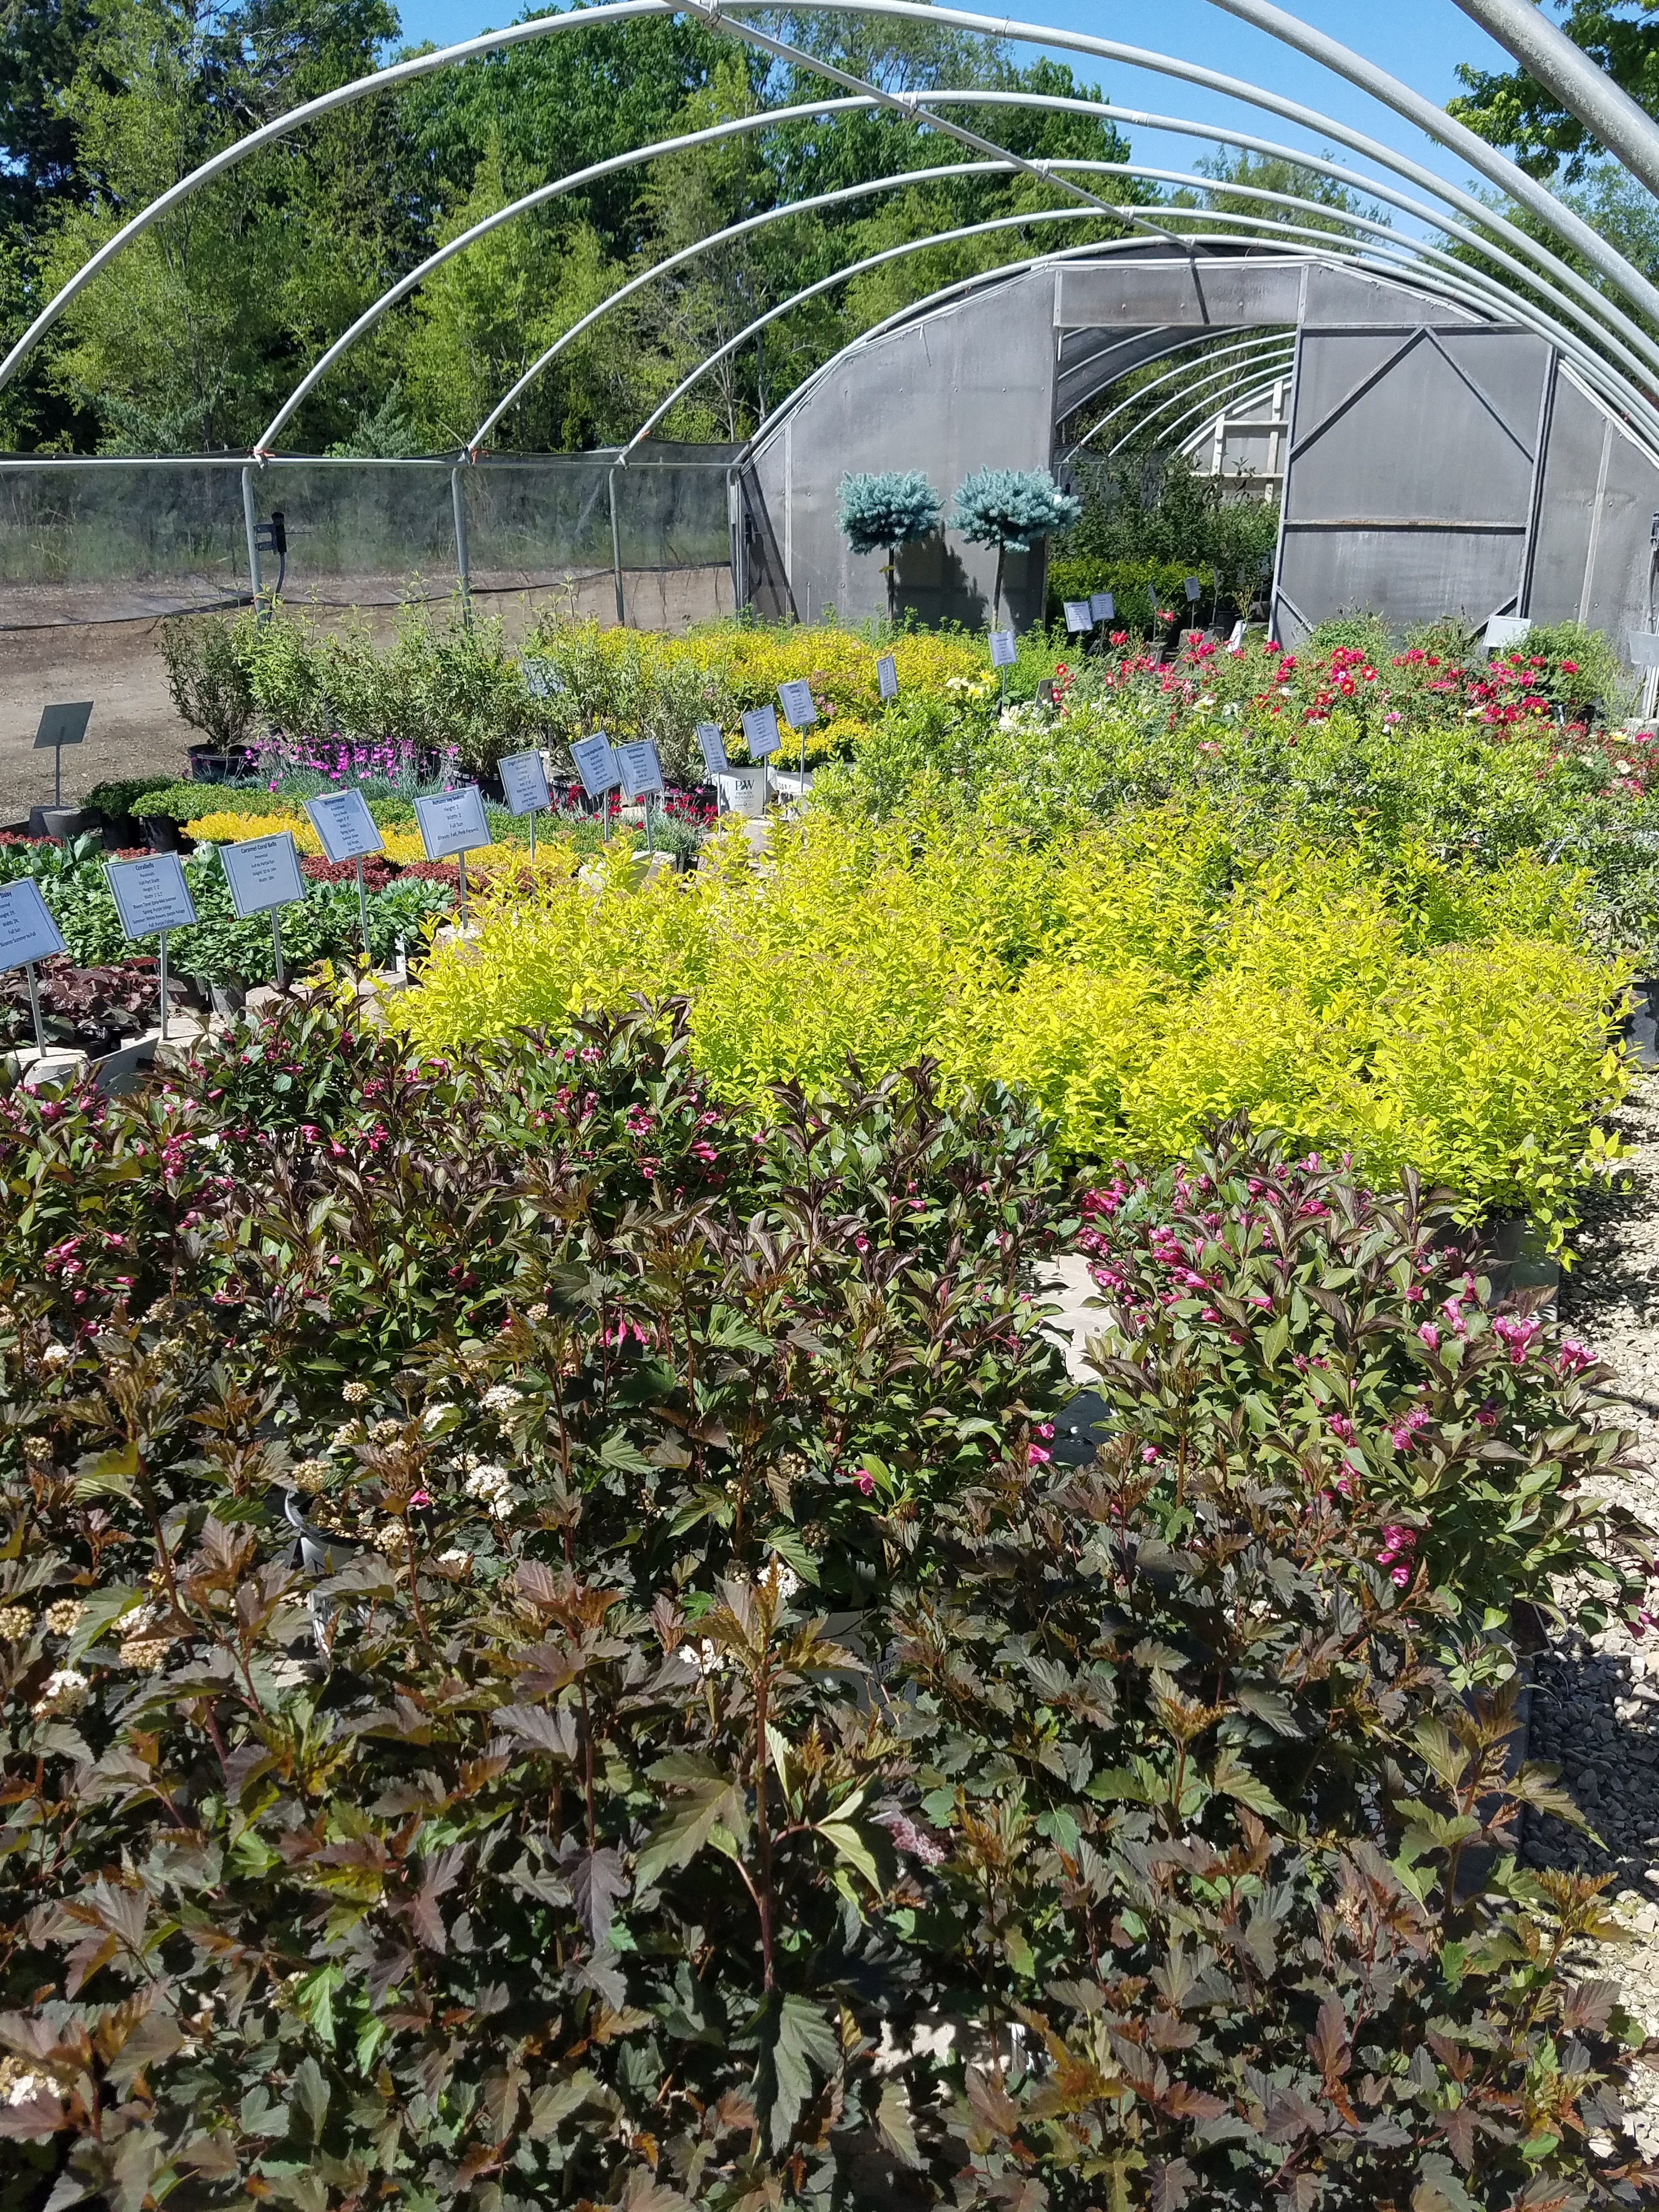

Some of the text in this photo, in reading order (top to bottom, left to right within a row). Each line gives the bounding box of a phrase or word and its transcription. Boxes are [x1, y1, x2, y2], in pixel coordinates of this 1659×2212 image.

[735, 779, 755, 791] PW
[135, 862, 154, 871] Coralbells
[0, 891, 12, 899] Daisy
